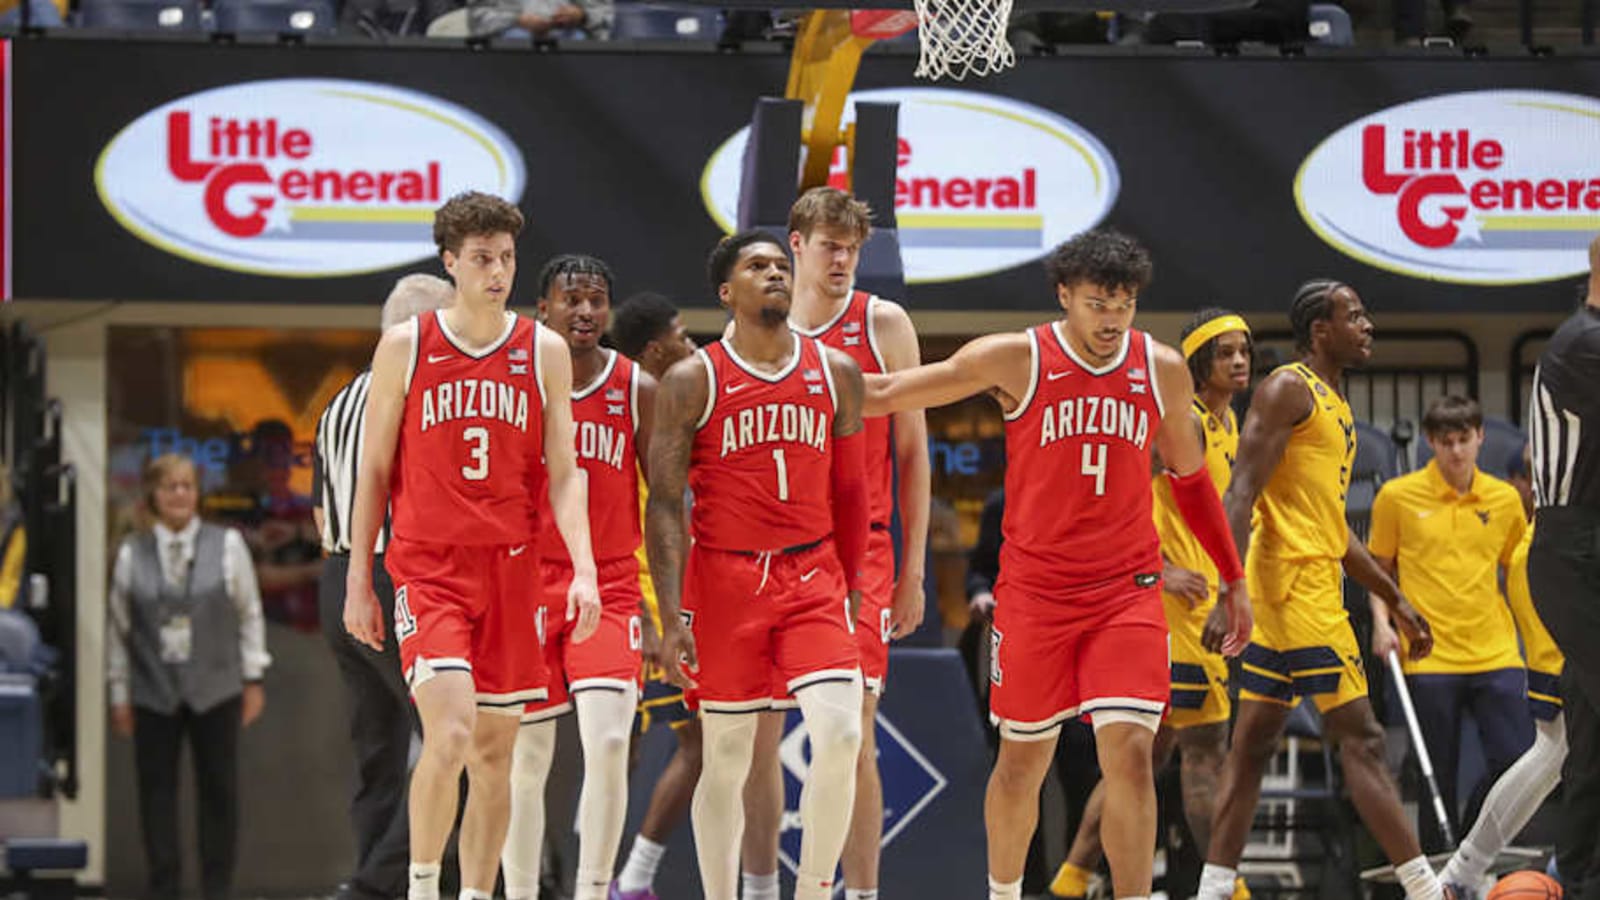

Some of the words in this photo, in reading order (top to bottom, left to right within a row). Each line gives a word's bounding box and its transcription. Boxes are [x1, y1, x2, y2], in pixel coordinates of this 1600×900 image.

[167, 111, 312, 183] Little
[1362, 124, 1504, 195] Little
[204, 161, 440, 238] General
[894, 168, 1036, 208] neral
[1397, 173, 1600, 249] Genera
[421, 379, 528, 432] ARIZONA
[720, 403, 827, 458] ARIZONA
[1040, 397, 1148, 450] ARIZONA
[461, 427, 490, 481] 3
[772, 448, 789, 501] 1
[1081, 443, 1108, 496] 4
